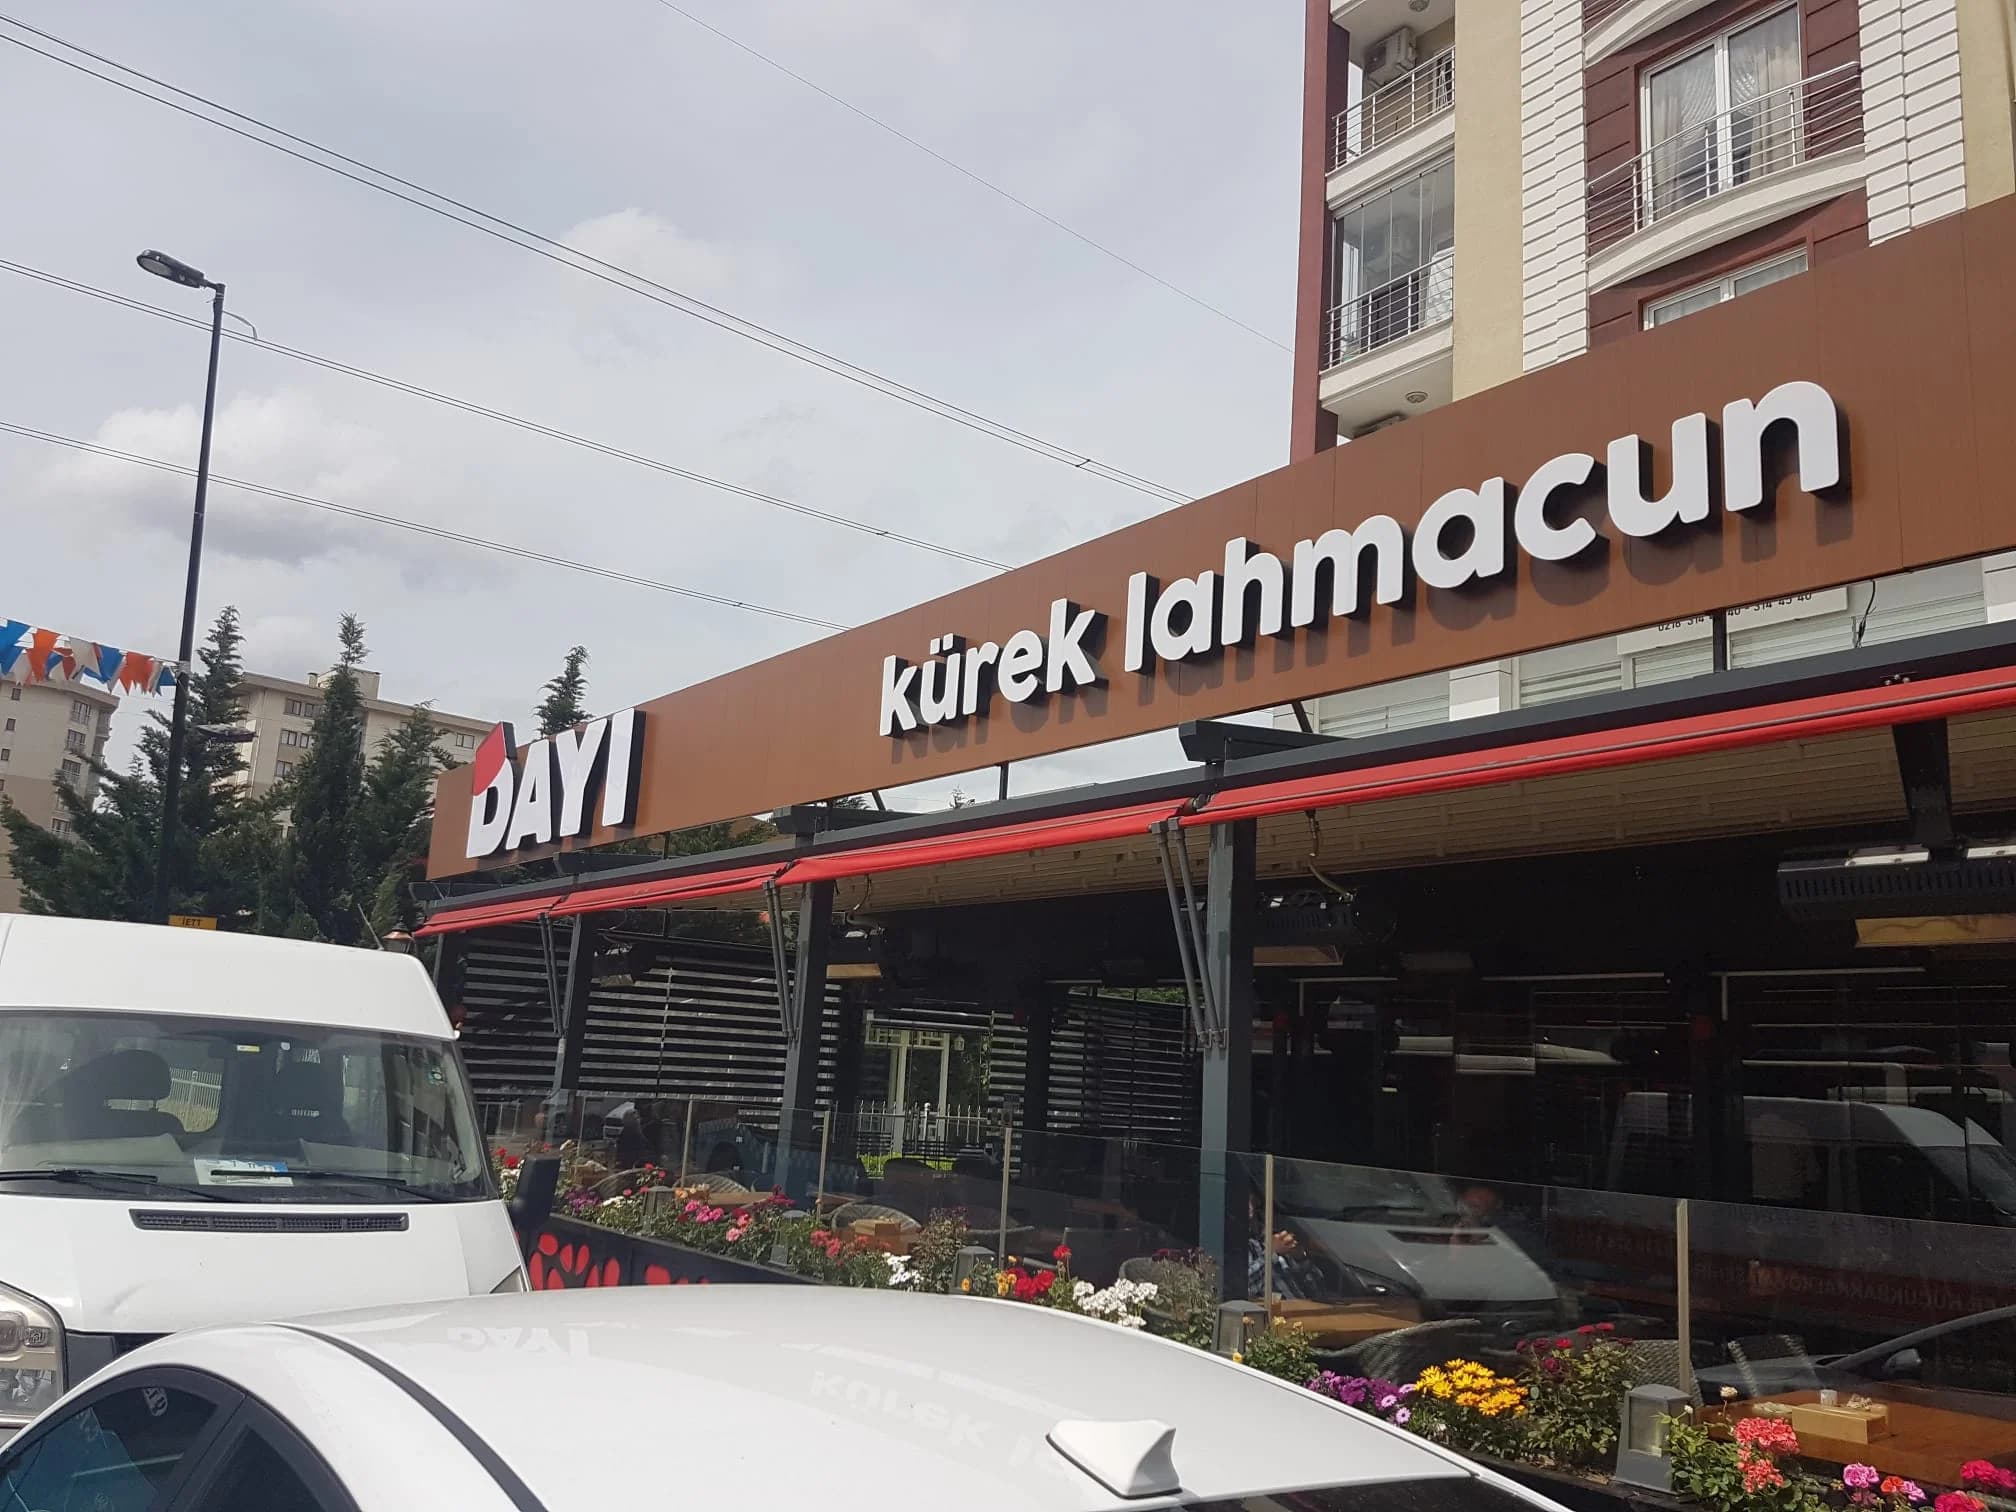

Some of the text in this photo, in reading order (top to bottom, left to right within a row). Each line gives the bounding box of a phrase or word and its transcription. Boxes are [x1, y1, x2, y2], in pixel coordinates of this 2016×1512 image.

[880, 381, 1839, 737] kürek lahmacun
[466, 708, 637, 859] DAYI
